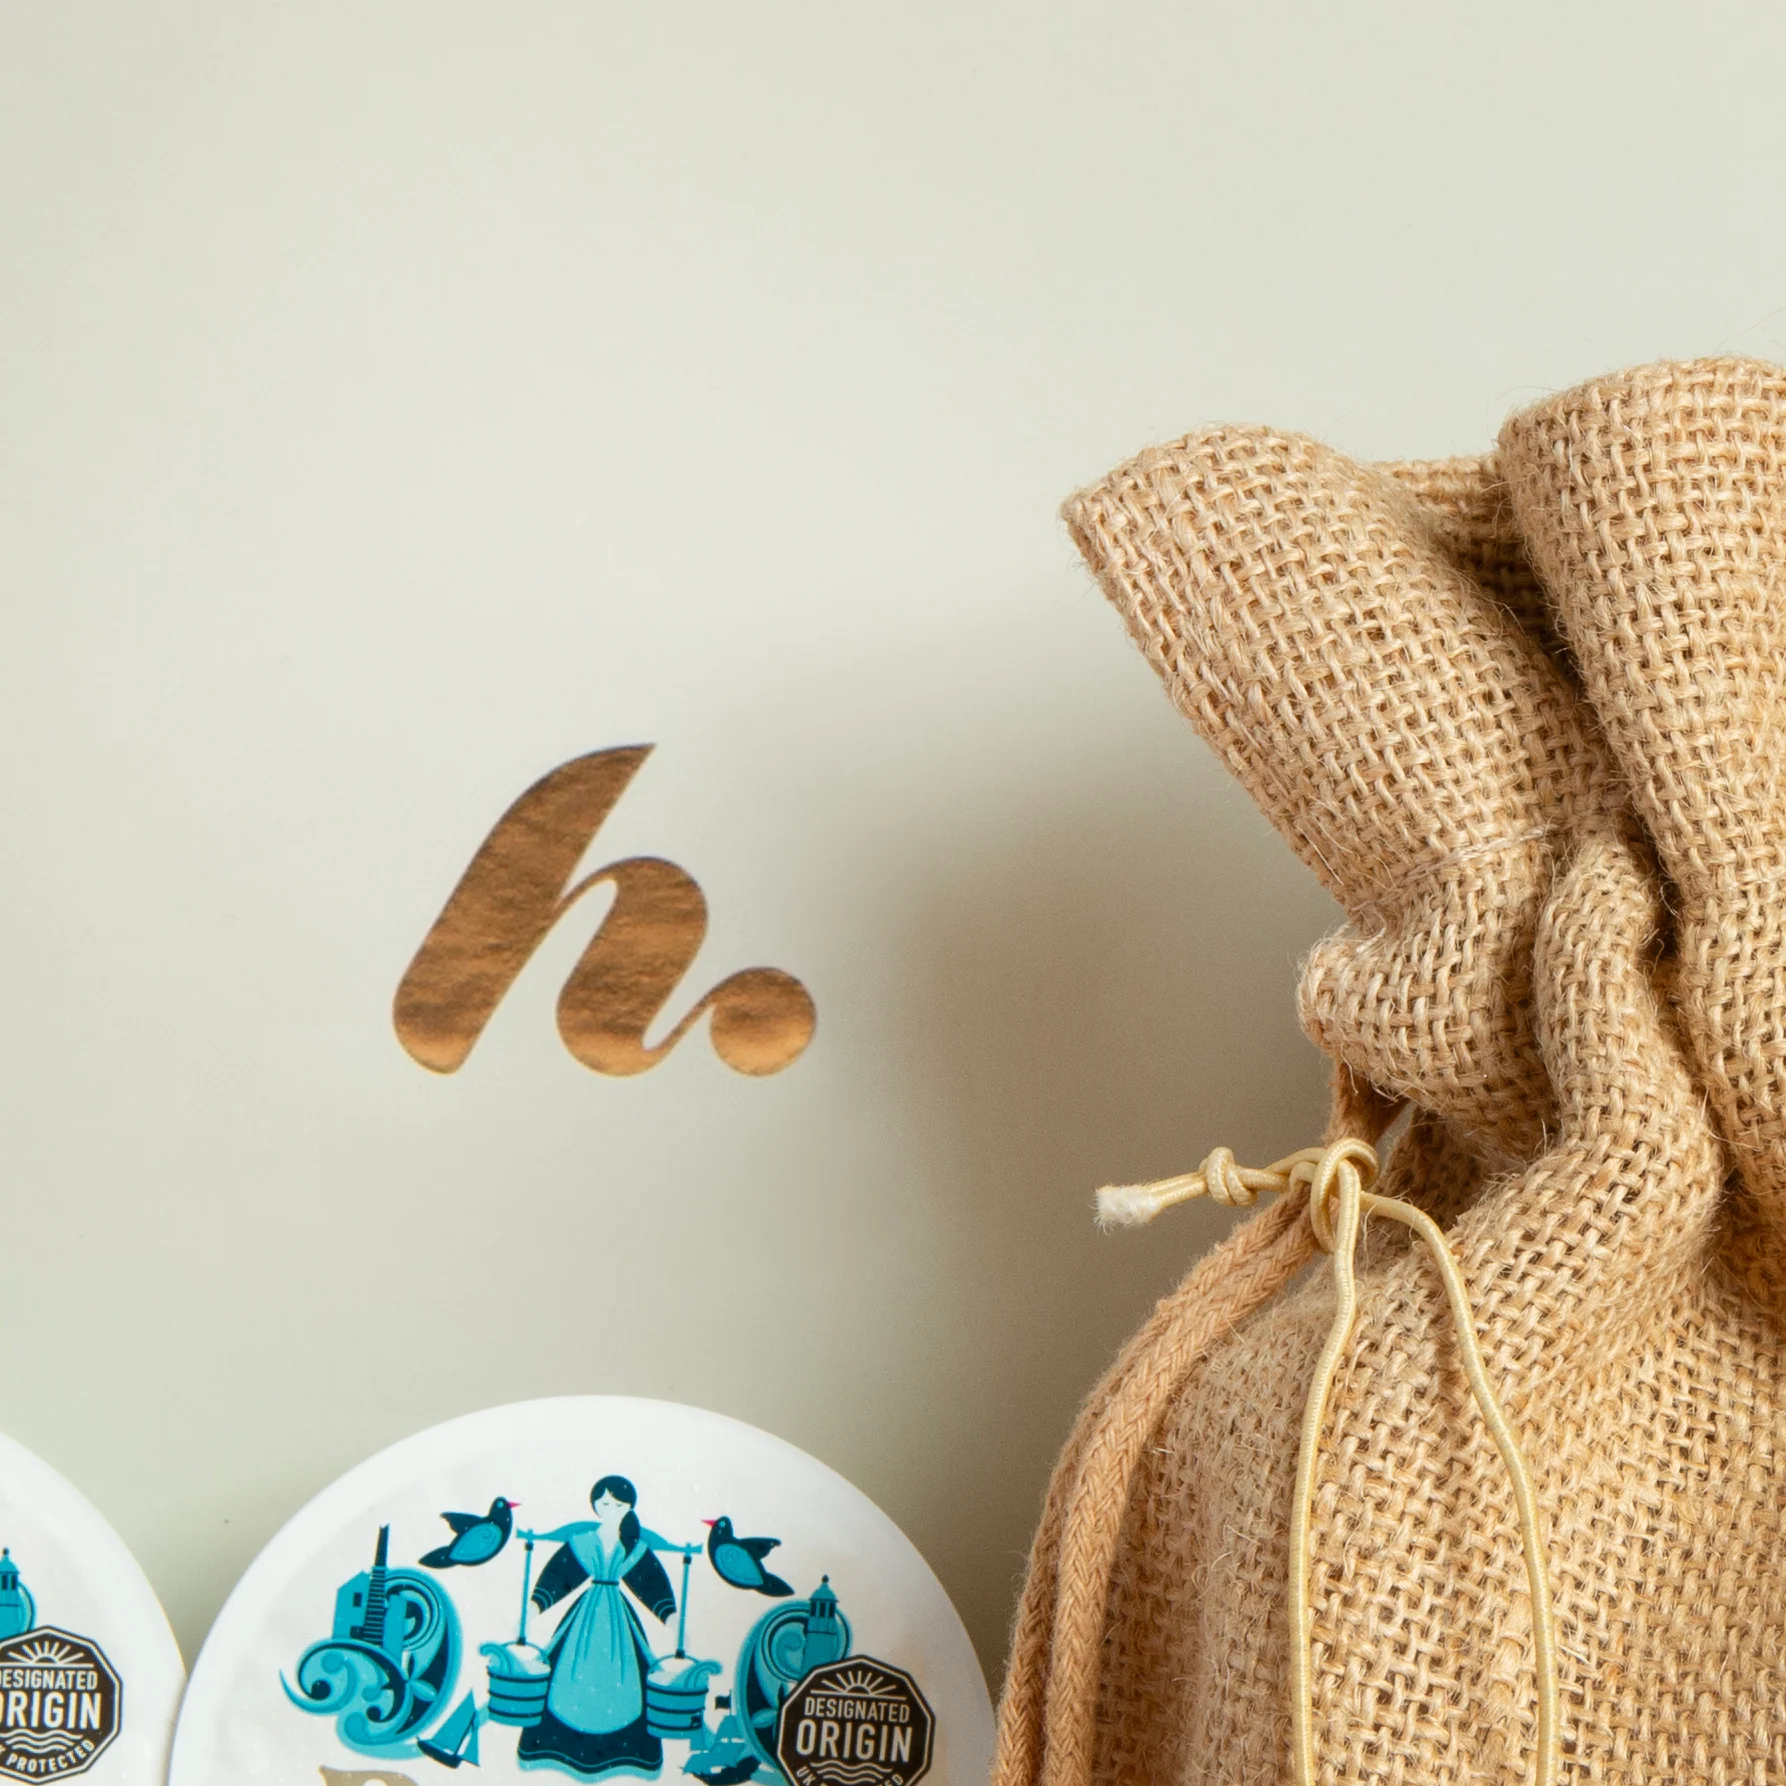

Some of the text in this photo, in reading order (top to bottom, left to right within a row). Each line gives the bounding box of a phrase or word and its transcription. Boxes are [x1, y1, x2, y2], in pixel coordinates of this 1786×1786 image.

[0, 1669, 98, 1691] ESIGNATED
[0, 1690, 102, 1730] RIGIN
[804, 1697, 910, 1723] DESIGNATED
[5, 1740, 95, 1773] PROTECTED
[796, 1719, 913, 1763] ORIGIN
